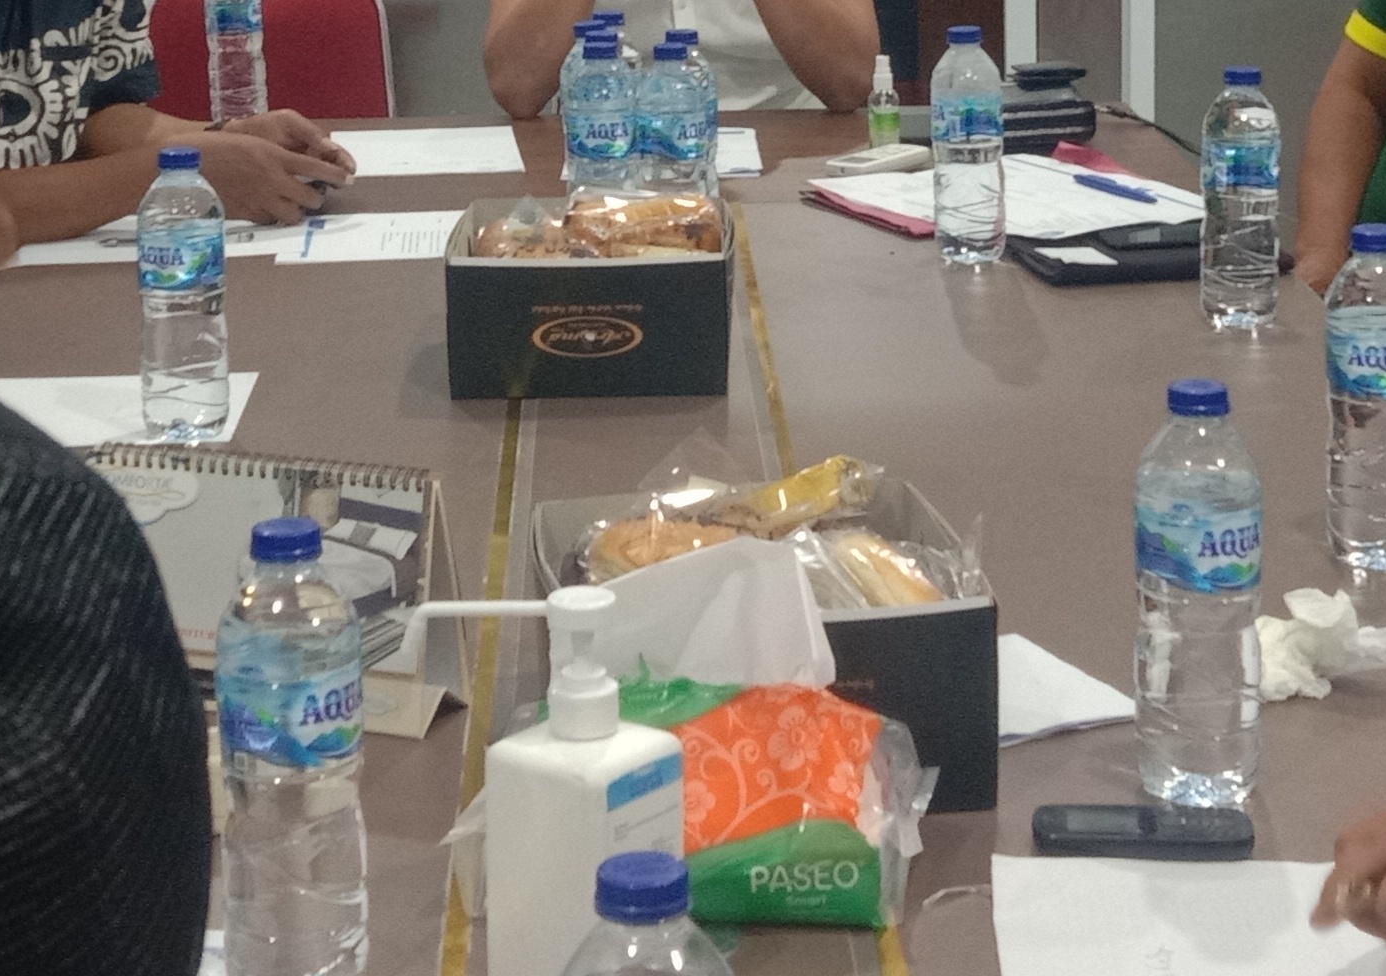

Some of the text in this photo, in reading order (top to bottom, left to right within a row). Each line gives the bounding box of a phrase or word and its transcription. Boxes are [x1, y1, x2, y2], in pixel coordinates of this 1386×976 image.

[585, 121, 629, 142] AQUA
[1198, 522, 1260, 559] AQUA
[750, 859, 859, 893] PASEO
